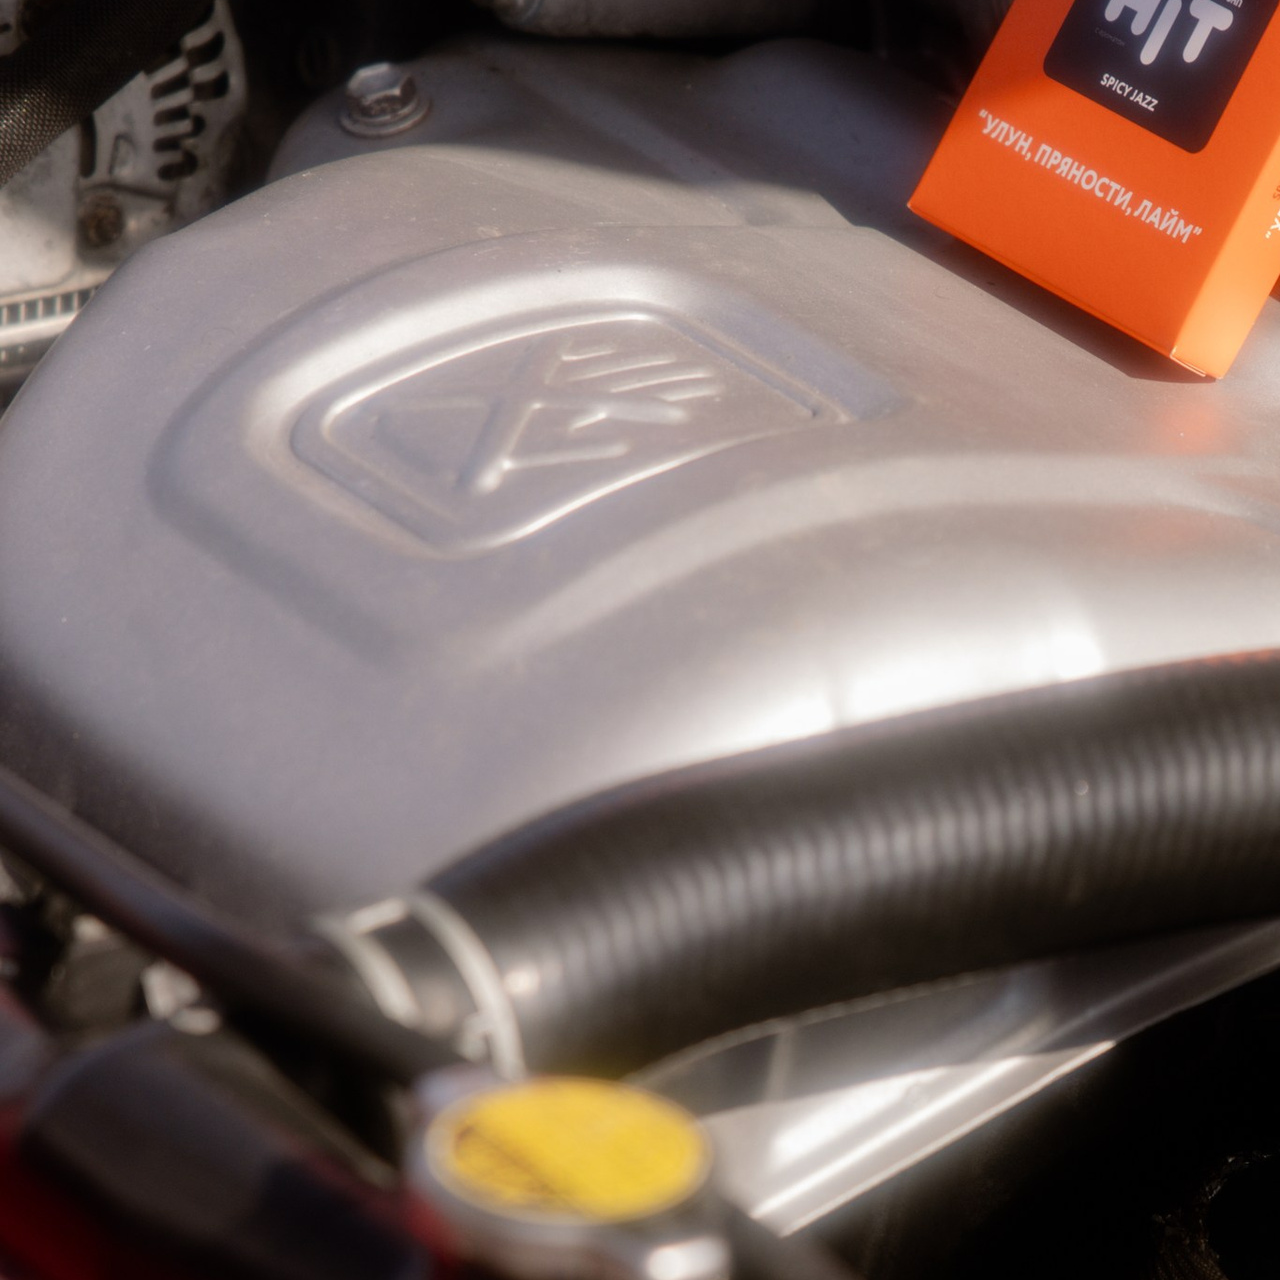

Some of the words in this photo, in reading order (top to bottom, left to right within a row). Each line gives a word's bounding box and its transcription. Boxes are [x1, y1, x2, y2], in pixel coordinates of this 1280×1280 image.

[1100, 73, 1132, 98] SPICY
[1130, 89, 1158, 111] JAZZ
[1034, 143, 1133, 216] ПРЯНОСТИ,
